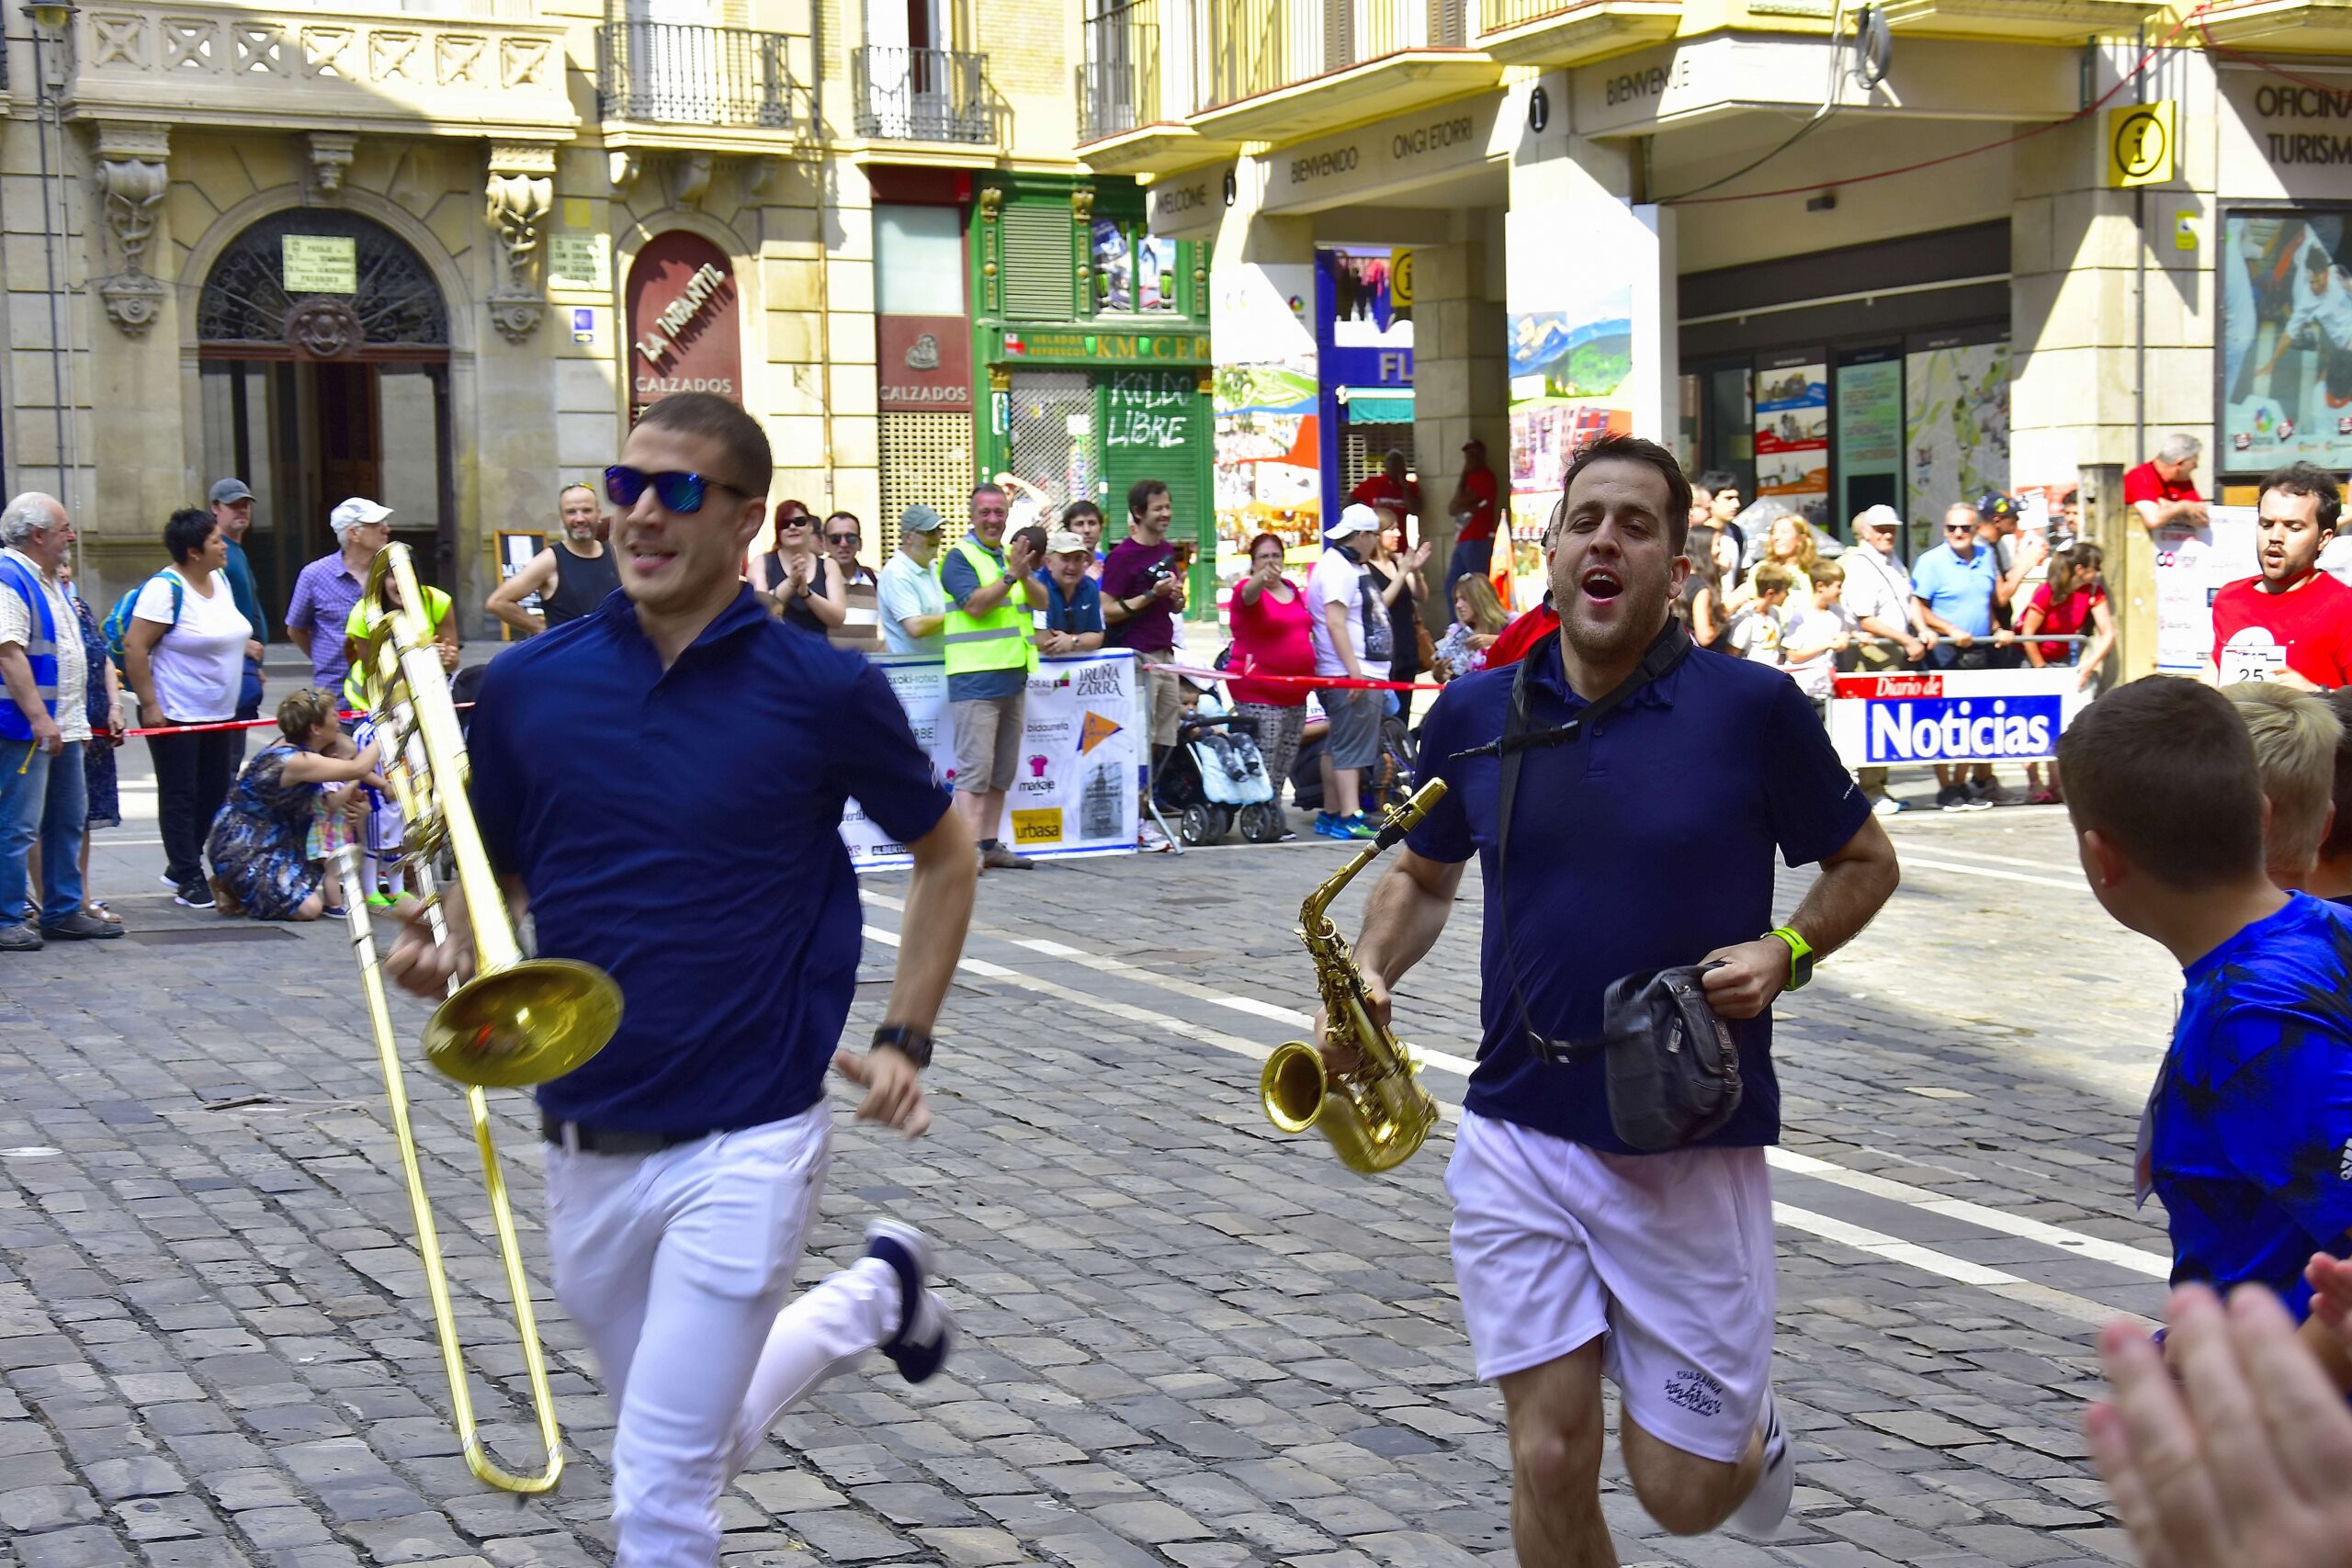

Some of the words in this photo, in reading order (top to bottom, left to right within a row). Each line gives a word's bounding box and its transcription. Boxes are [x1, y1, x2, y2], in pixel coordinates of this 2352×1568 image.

[1606, 60, 1690, 107] BIENVENUE
[1393, 130, 1427, 160] ONGI
[1430, 116, 1473, 150] ETORRI
[1291, 146, 1358, 184] BIENVENIDO
[1157, 184, 1206, 215] WELCOME
[635, 332, 669, 362] LA
[656, 262, 726, 338] INFANTIL
[1096, 335, 1137, 359] KM
[1380, 352, 1413, 382] FL
[635, 377, 733, 394] CALZADOS
[879, 386, 967, 401] CALZADOS
[1112, 371, 1192, 409] KOLDO
[1106, 411, 1187, 448] LIBRE
[1077, 680, 1125, 696] ZARRA
[1079, 663, 1120, 684] IRUÑA
[1875, 677, 1922, 697] Diario
[1923, 679, 1941, 696] de
[1871, 699, 2051, 760] Noticias
[1019, 778, 1055, 794] markaje
[1015, 823, 1059, 839] urbasa
